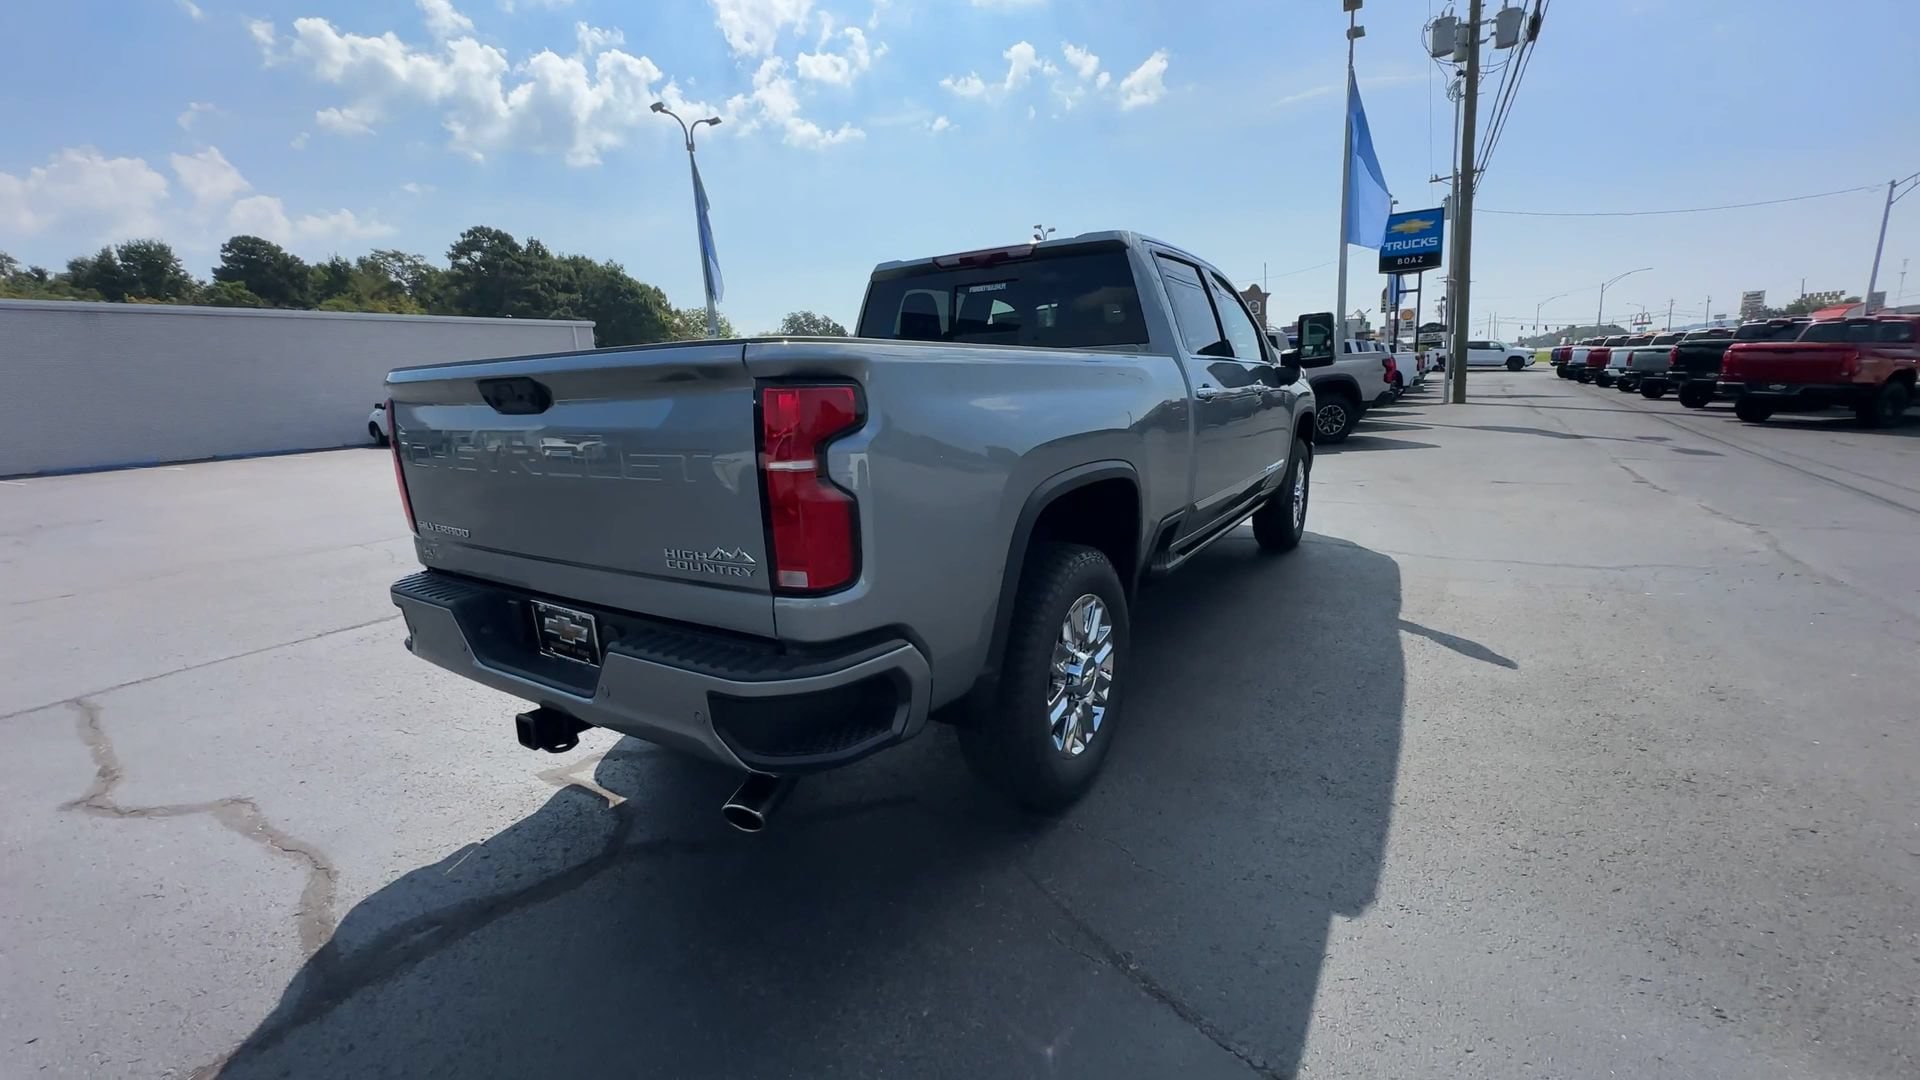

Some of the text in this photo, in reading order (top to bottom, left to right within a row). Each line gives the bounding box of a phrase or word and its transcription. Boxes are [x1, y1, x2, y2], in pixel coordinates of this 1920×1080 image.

[1384, 236, 1438, 251] TRUCKS
[1397, 255, 1424, 265] BOAZ
[417, 520, 470, 538] SILVERADO
[664, 548, 707, 561] HIGH
[665, 559, 755, 577] COUNTRY
